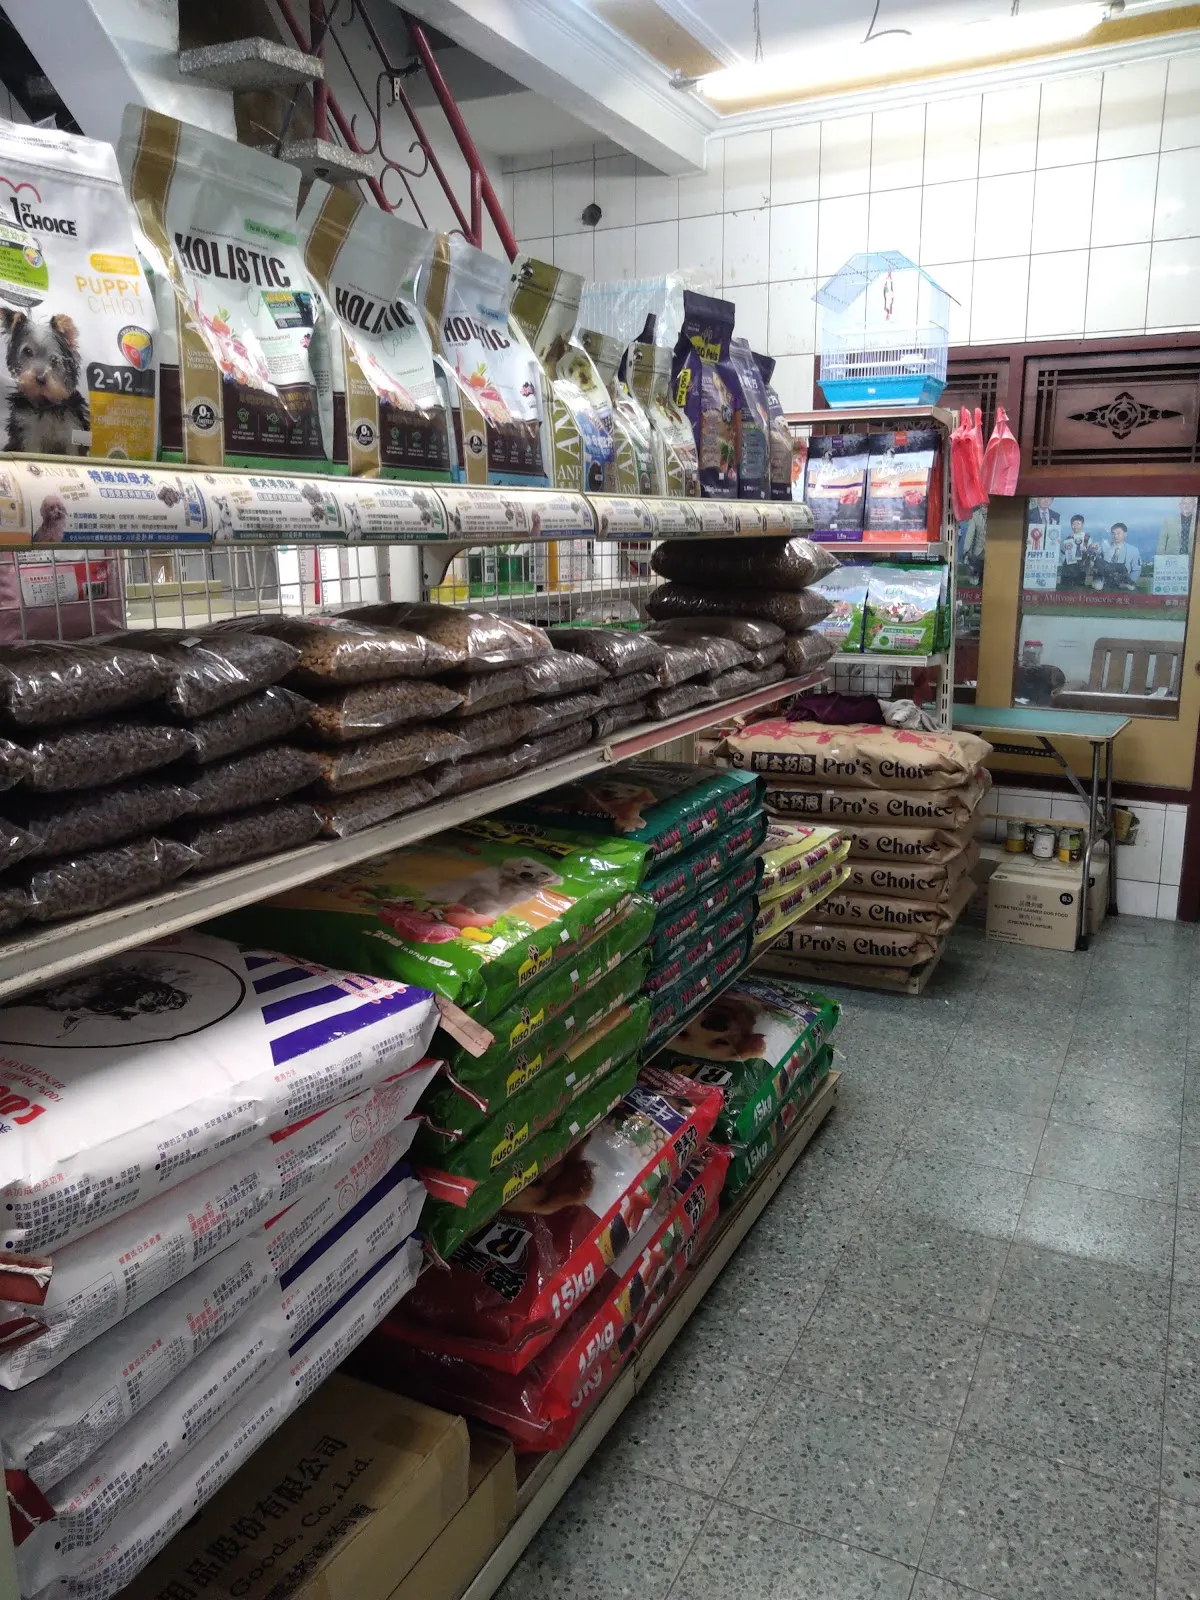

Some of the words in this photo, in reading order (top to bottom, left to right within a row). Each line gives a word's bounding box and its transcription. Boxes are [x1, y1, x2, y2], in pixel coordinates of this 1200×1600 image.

[22, 213, 77, 237] CHOICE
[174, 232, 291, 288] HOLISTIC
[75, 275, 140, 297] PUPPY
[87, 295, 145, 316] CHIOT
[93, 368, 134, 393] 2-12
[680, 370, 690, 389] FUSO
[823, 757, 873, 777] Pro's
[829, 797, 879, 815] Pro's
[800, 934, 847, 952] Pro's
[520, 966, 538, 985] FUSO
[537, 956, 551, 972] Pets
[511, 1029, 529, 1048] FUSO
[529, 1019, 544, 1036] Pets
[507, 1076, 527, 1096] FUSO
[526, 1064, 542, 1081] Pets
[753, 1096, 773, 1128] 15kg
[492, 1145, 513, 1166] FUSO
[512, 1132, 528, 1151] Pets
[503, 1181, 523, 1202] FUSO
[522, 1170, 538, 1187] Pets
[551, 1261, 596, 1320] 15kg
[578, 1321, 615, 1378] 15kg
[230, 1534, 304, 1598] Goods,
